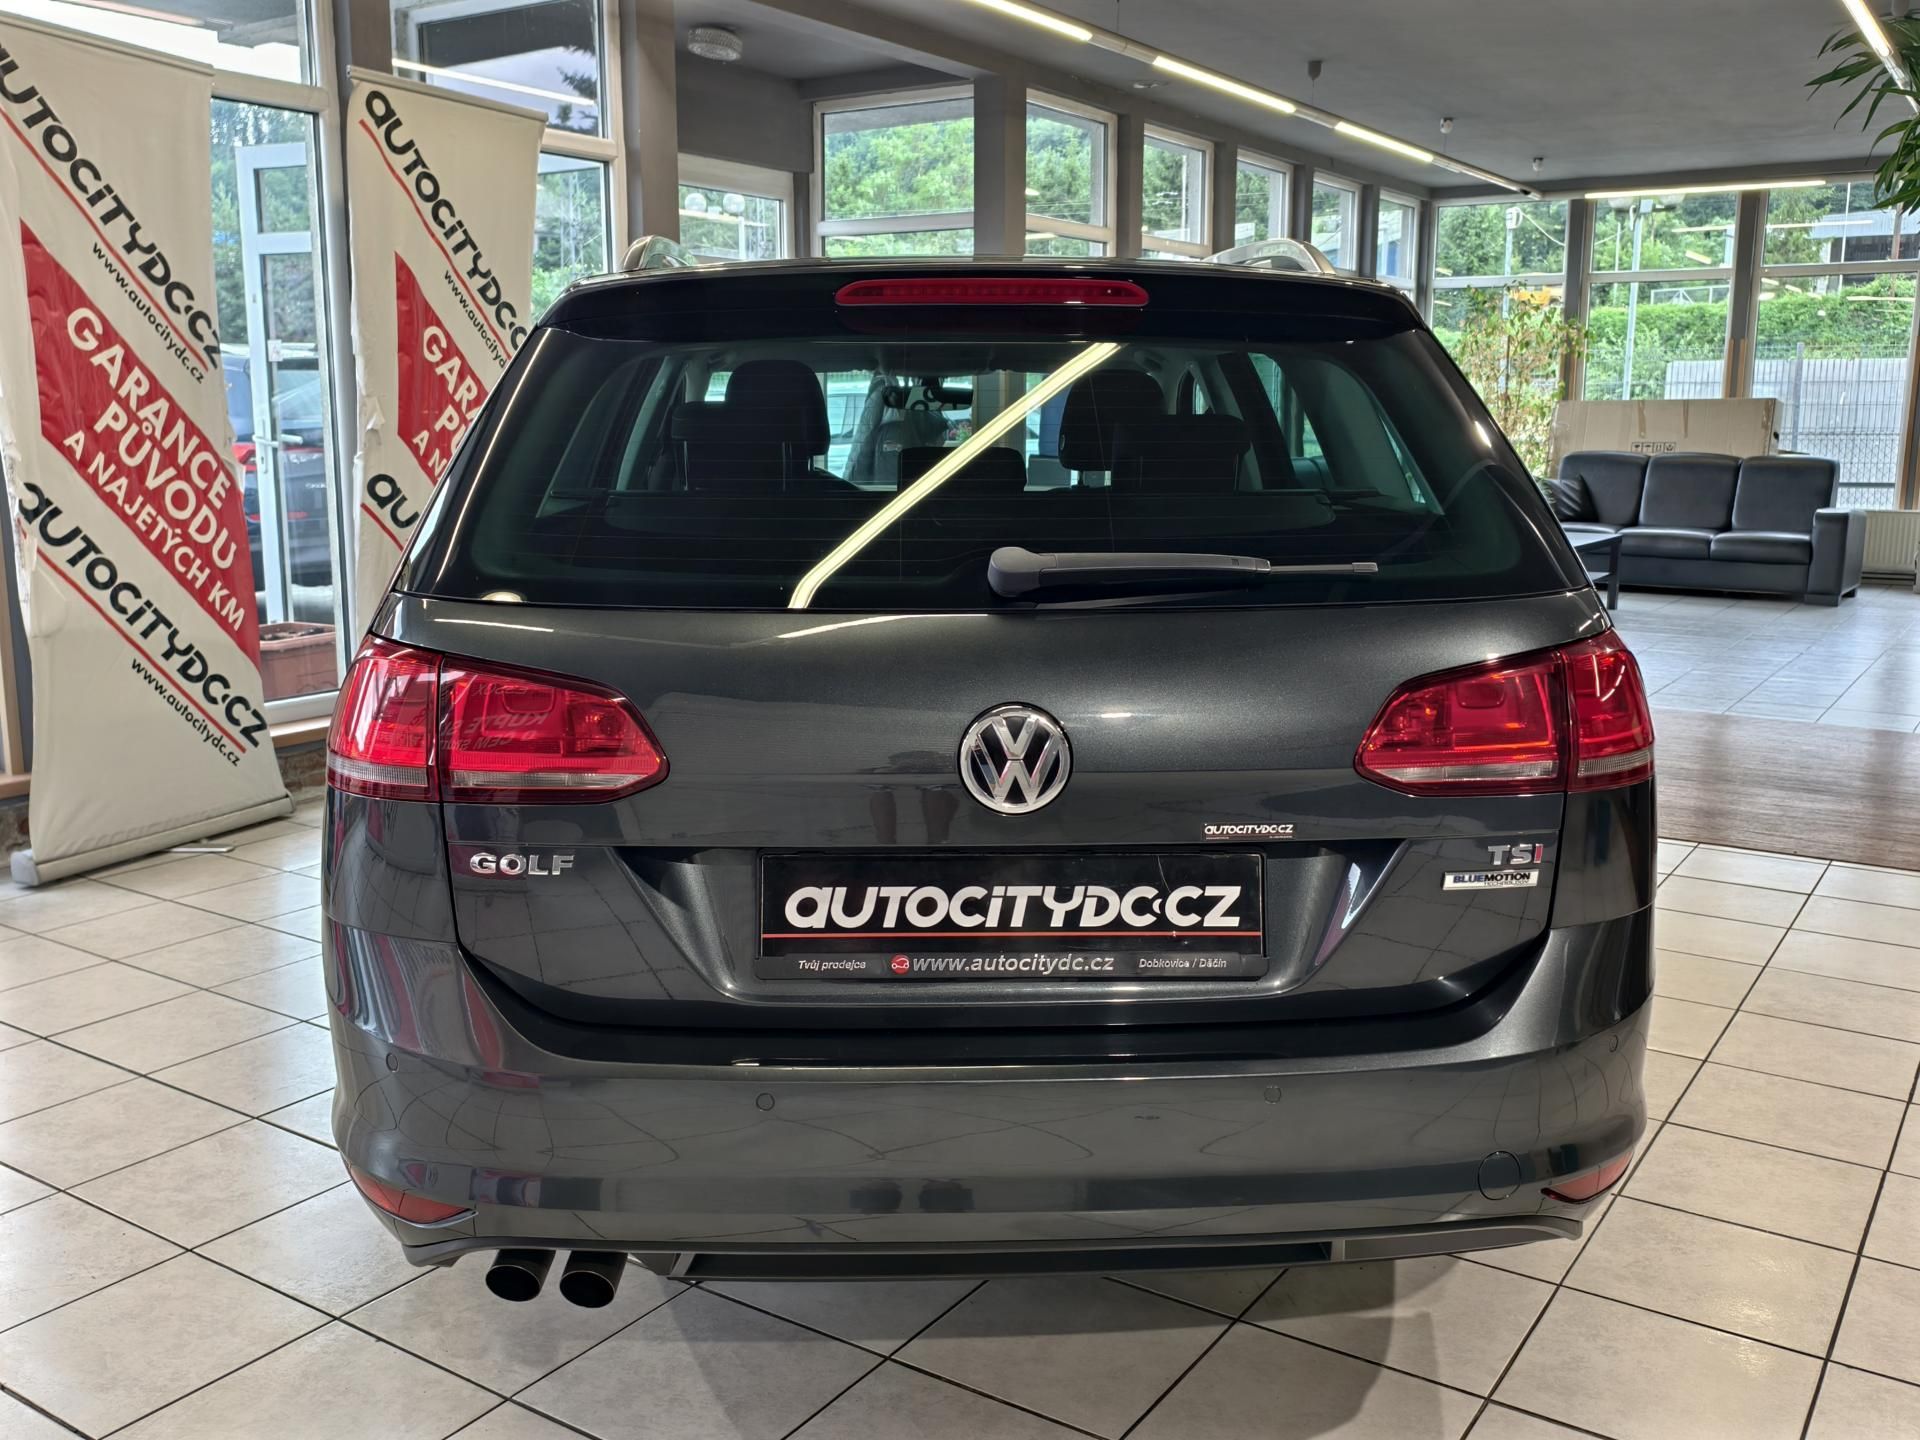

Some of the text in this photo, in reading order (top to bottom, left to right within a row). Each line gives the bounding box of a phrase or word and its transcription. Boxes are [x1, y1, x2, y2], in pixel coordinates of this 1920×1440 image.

[92, 241, 205, 385] www.autocitydc.cz
[444, 269, 508, 369] www.autocityd
[67, 307, 231, 510] GARANCE
[93, 400, 237, 569] PŮVODU
[412, 430, 451, 482] A N
[63, 429, 245, 631] A NAJETÝCH KM
[366, 473, 420, 529] aU
[131, 658, 241, 767] www.autocitydc.cz
[469, 851, 575, 876] GOLF
[1453, 872, 1531, 884] BLUEMOTION
[1487, 843, 1544, 866] TSI
[912, 953, 1115, 975] www.autocitydc.cz
